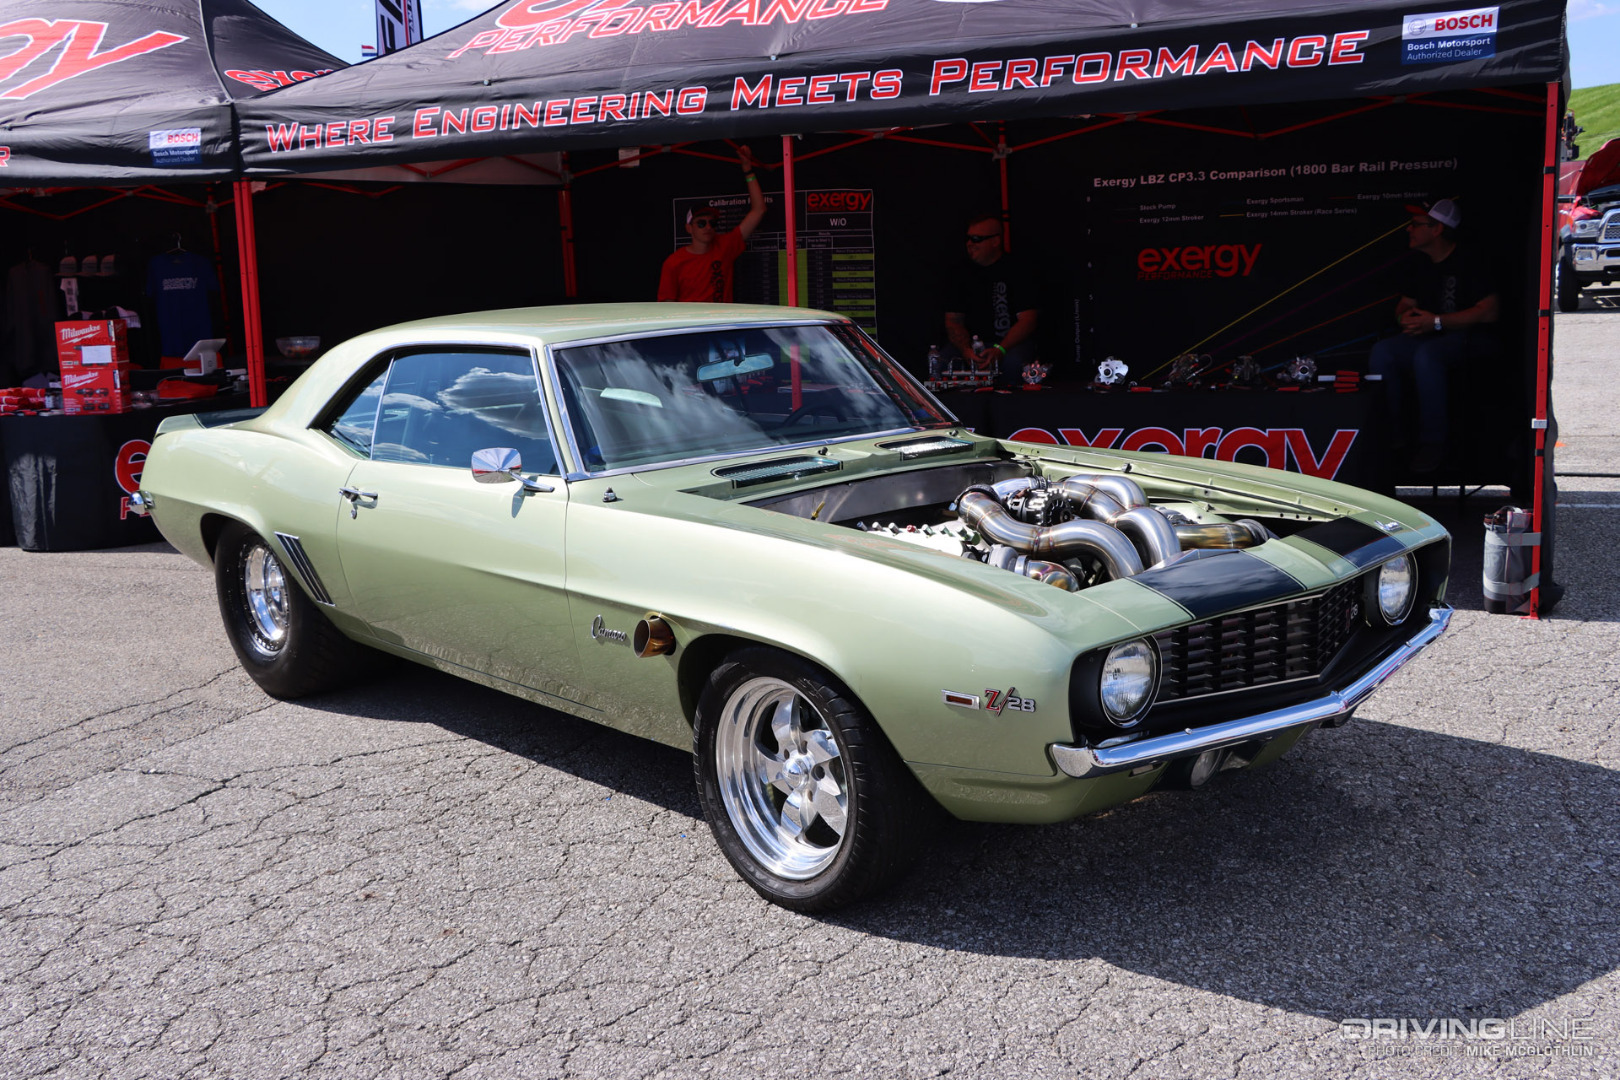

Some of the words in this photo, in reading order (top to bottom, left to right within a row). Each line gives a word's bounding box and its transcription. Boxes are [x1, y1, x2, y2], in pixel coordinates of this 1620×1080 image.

[1434, 13, 1494, 32] BOSCH
[1407, 41, 1435, 51] Bosch
[1437, 37, 1491, 49] Motorsport
[1406, 50, 1453, 61] Authorized
[1454, 48, 1483, 58] Dealer
[265, 115, 396, 154] WHERE
[412, 85, 709, 140] ENGINEERING
[729, 67, 903, 112] MEETS
[929, 29, 1372, 96] PERFORMANCE
[167, 132, 199, 144] BOSCH
[1093, 176, 1137, 189] Exergy
[1140, 173, 1166, 185] LBZ
[1168, 170, 1206, 183] CP3.3
[1209, 167, 1287, 181] Comparison
[1290, 163, 1327, 178] (1800
[1331, 163, 1355, 174] Bar
[1358, 160, 1386, 173] Rail
[1389, 156, 1458, 171] Pressure)
[708, 198, 747, 207] Calibration
[808, 192, 872, 212] exergy
[829, 217, 847, 227] W/O
[1137, 242, 1263, 278] exergy
[1136, 269, 1213, 281] PERFORMANCE
[60, 324, 101, 341] Milwaukee
[63, 371, 99, 386] Milwaukee
[591, 614, 626, 642] Camaro
[984, 686, 1036, 717] Z/28
